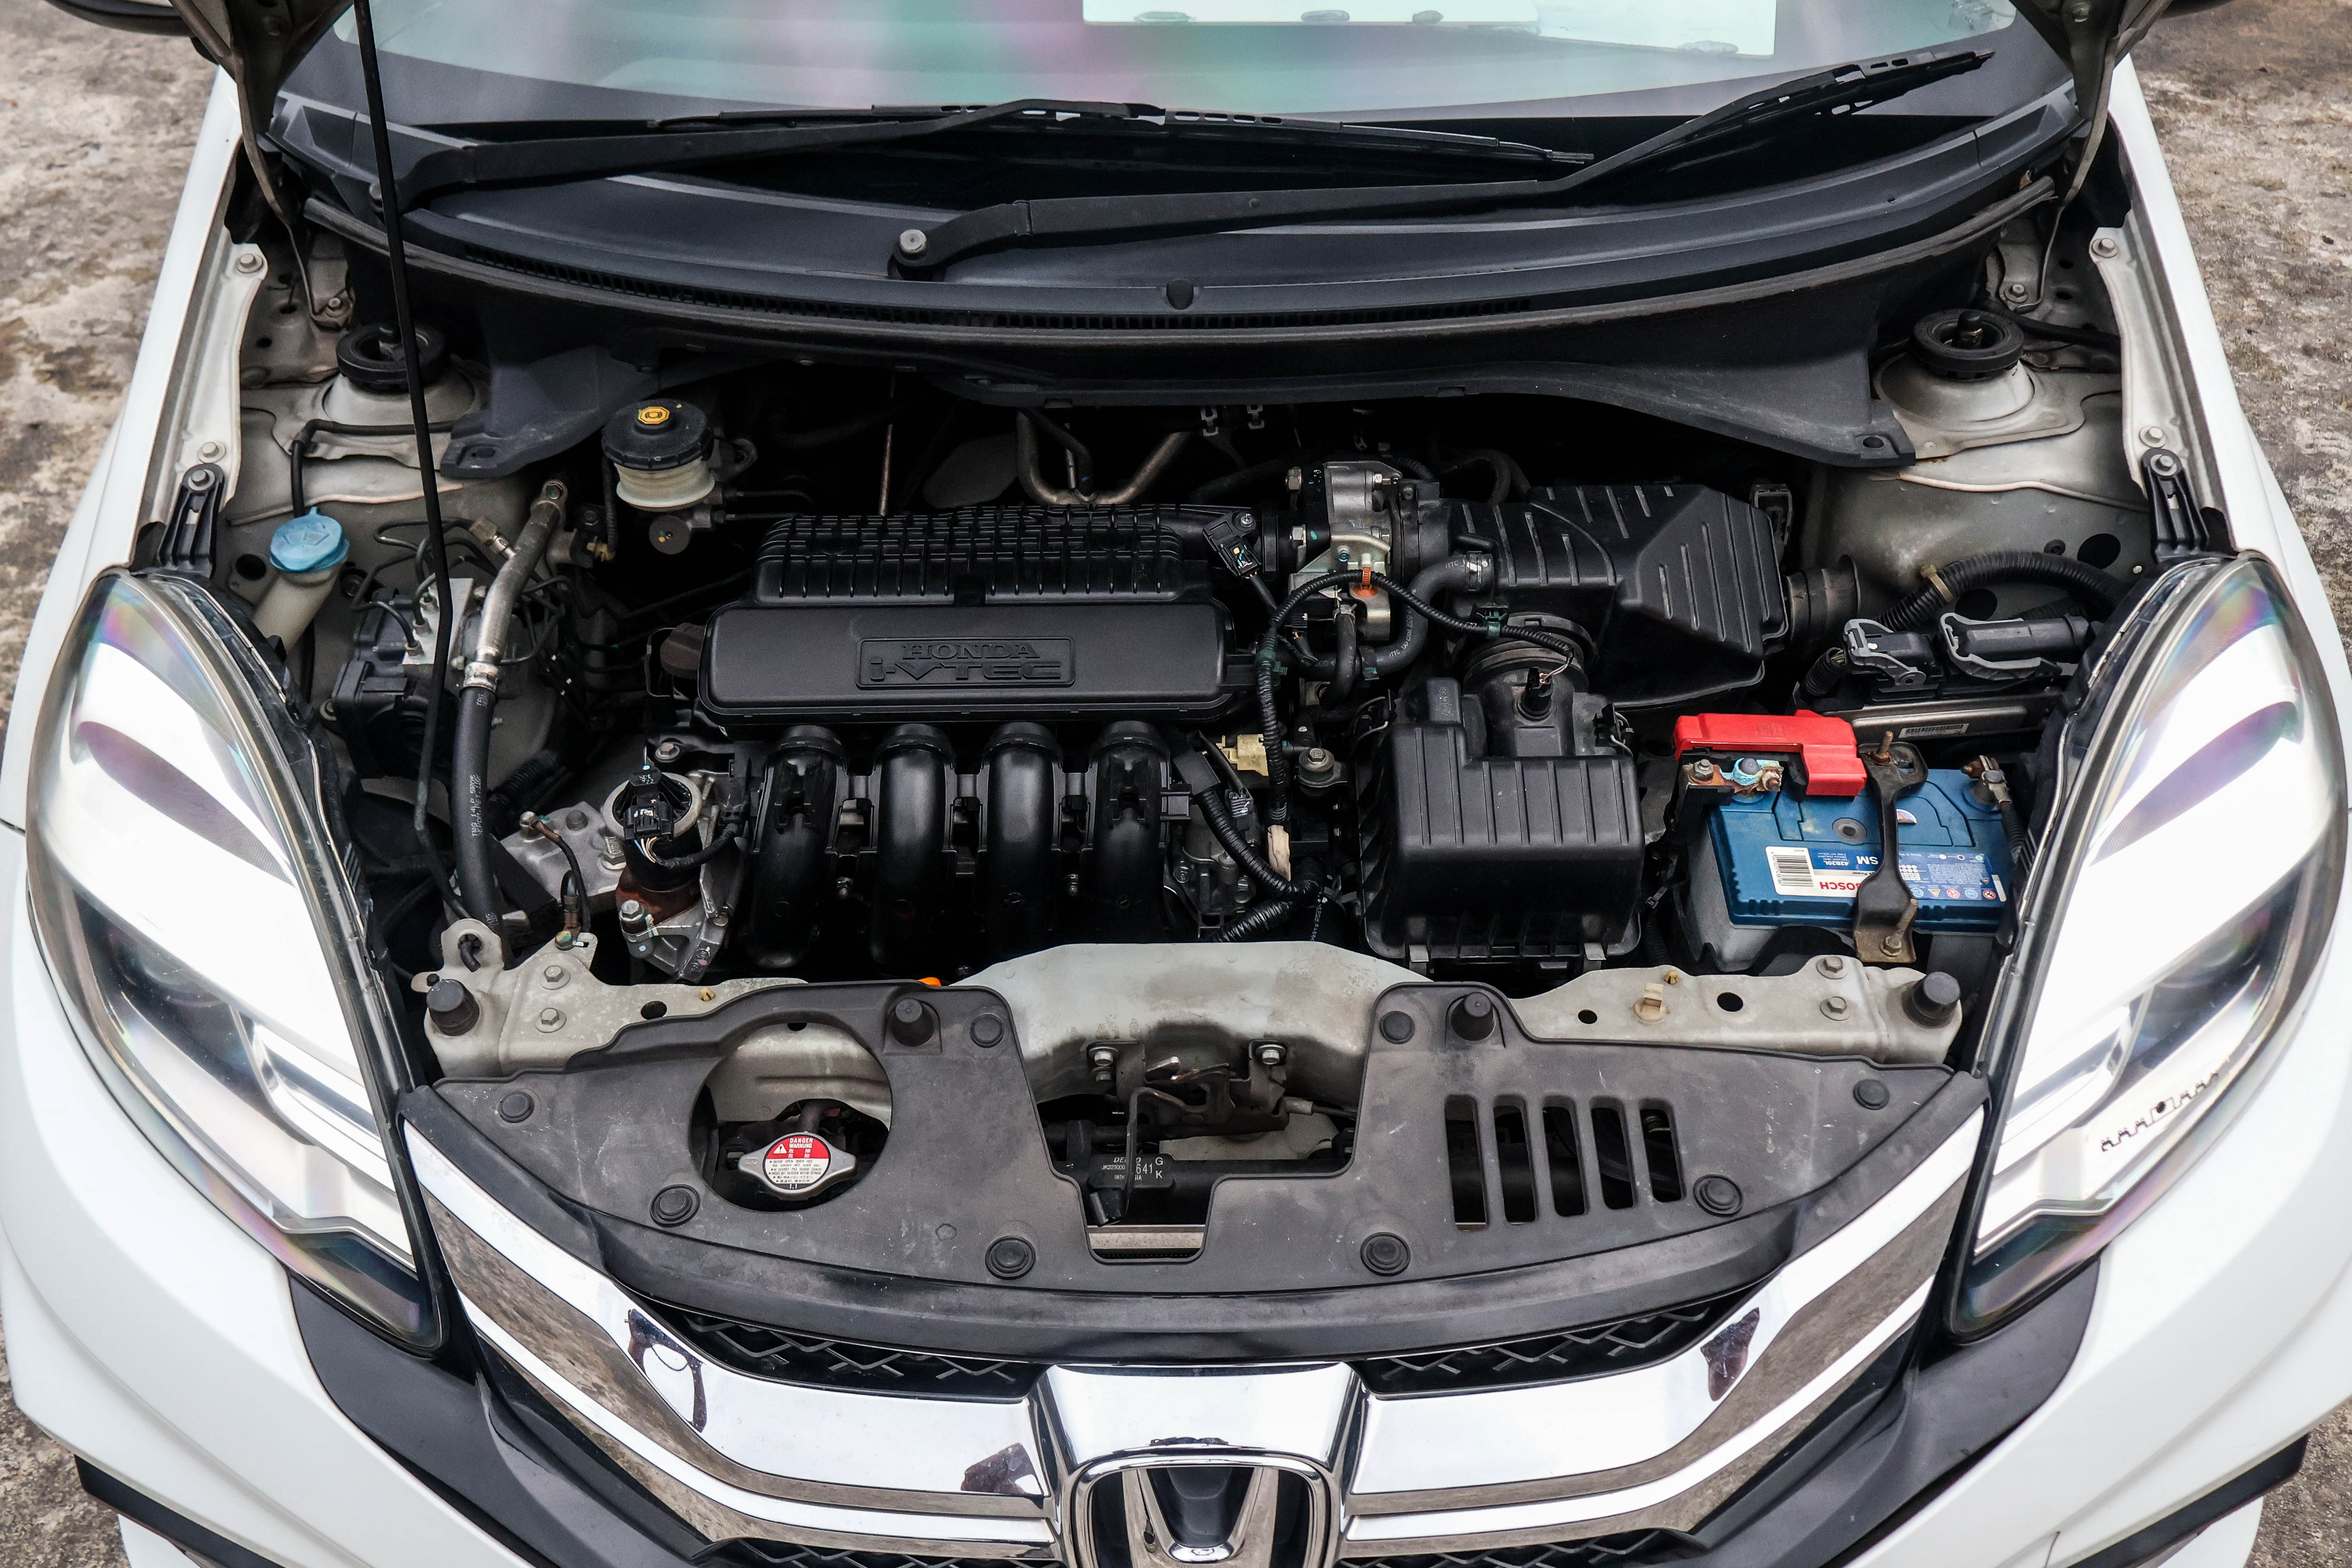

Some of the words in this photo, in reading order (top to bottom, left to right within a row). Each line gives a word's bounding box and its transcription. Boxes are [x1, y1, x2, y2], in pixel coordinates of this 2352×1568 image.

[903, 643, 1040, 660] HONDA
[870, 656, 1061, 681] i-VTEC
[1856, 856, 1878, 865] SM
[1155, 1157, 1164, 1165] G
[1156, 1170, 1162, 1179] K
